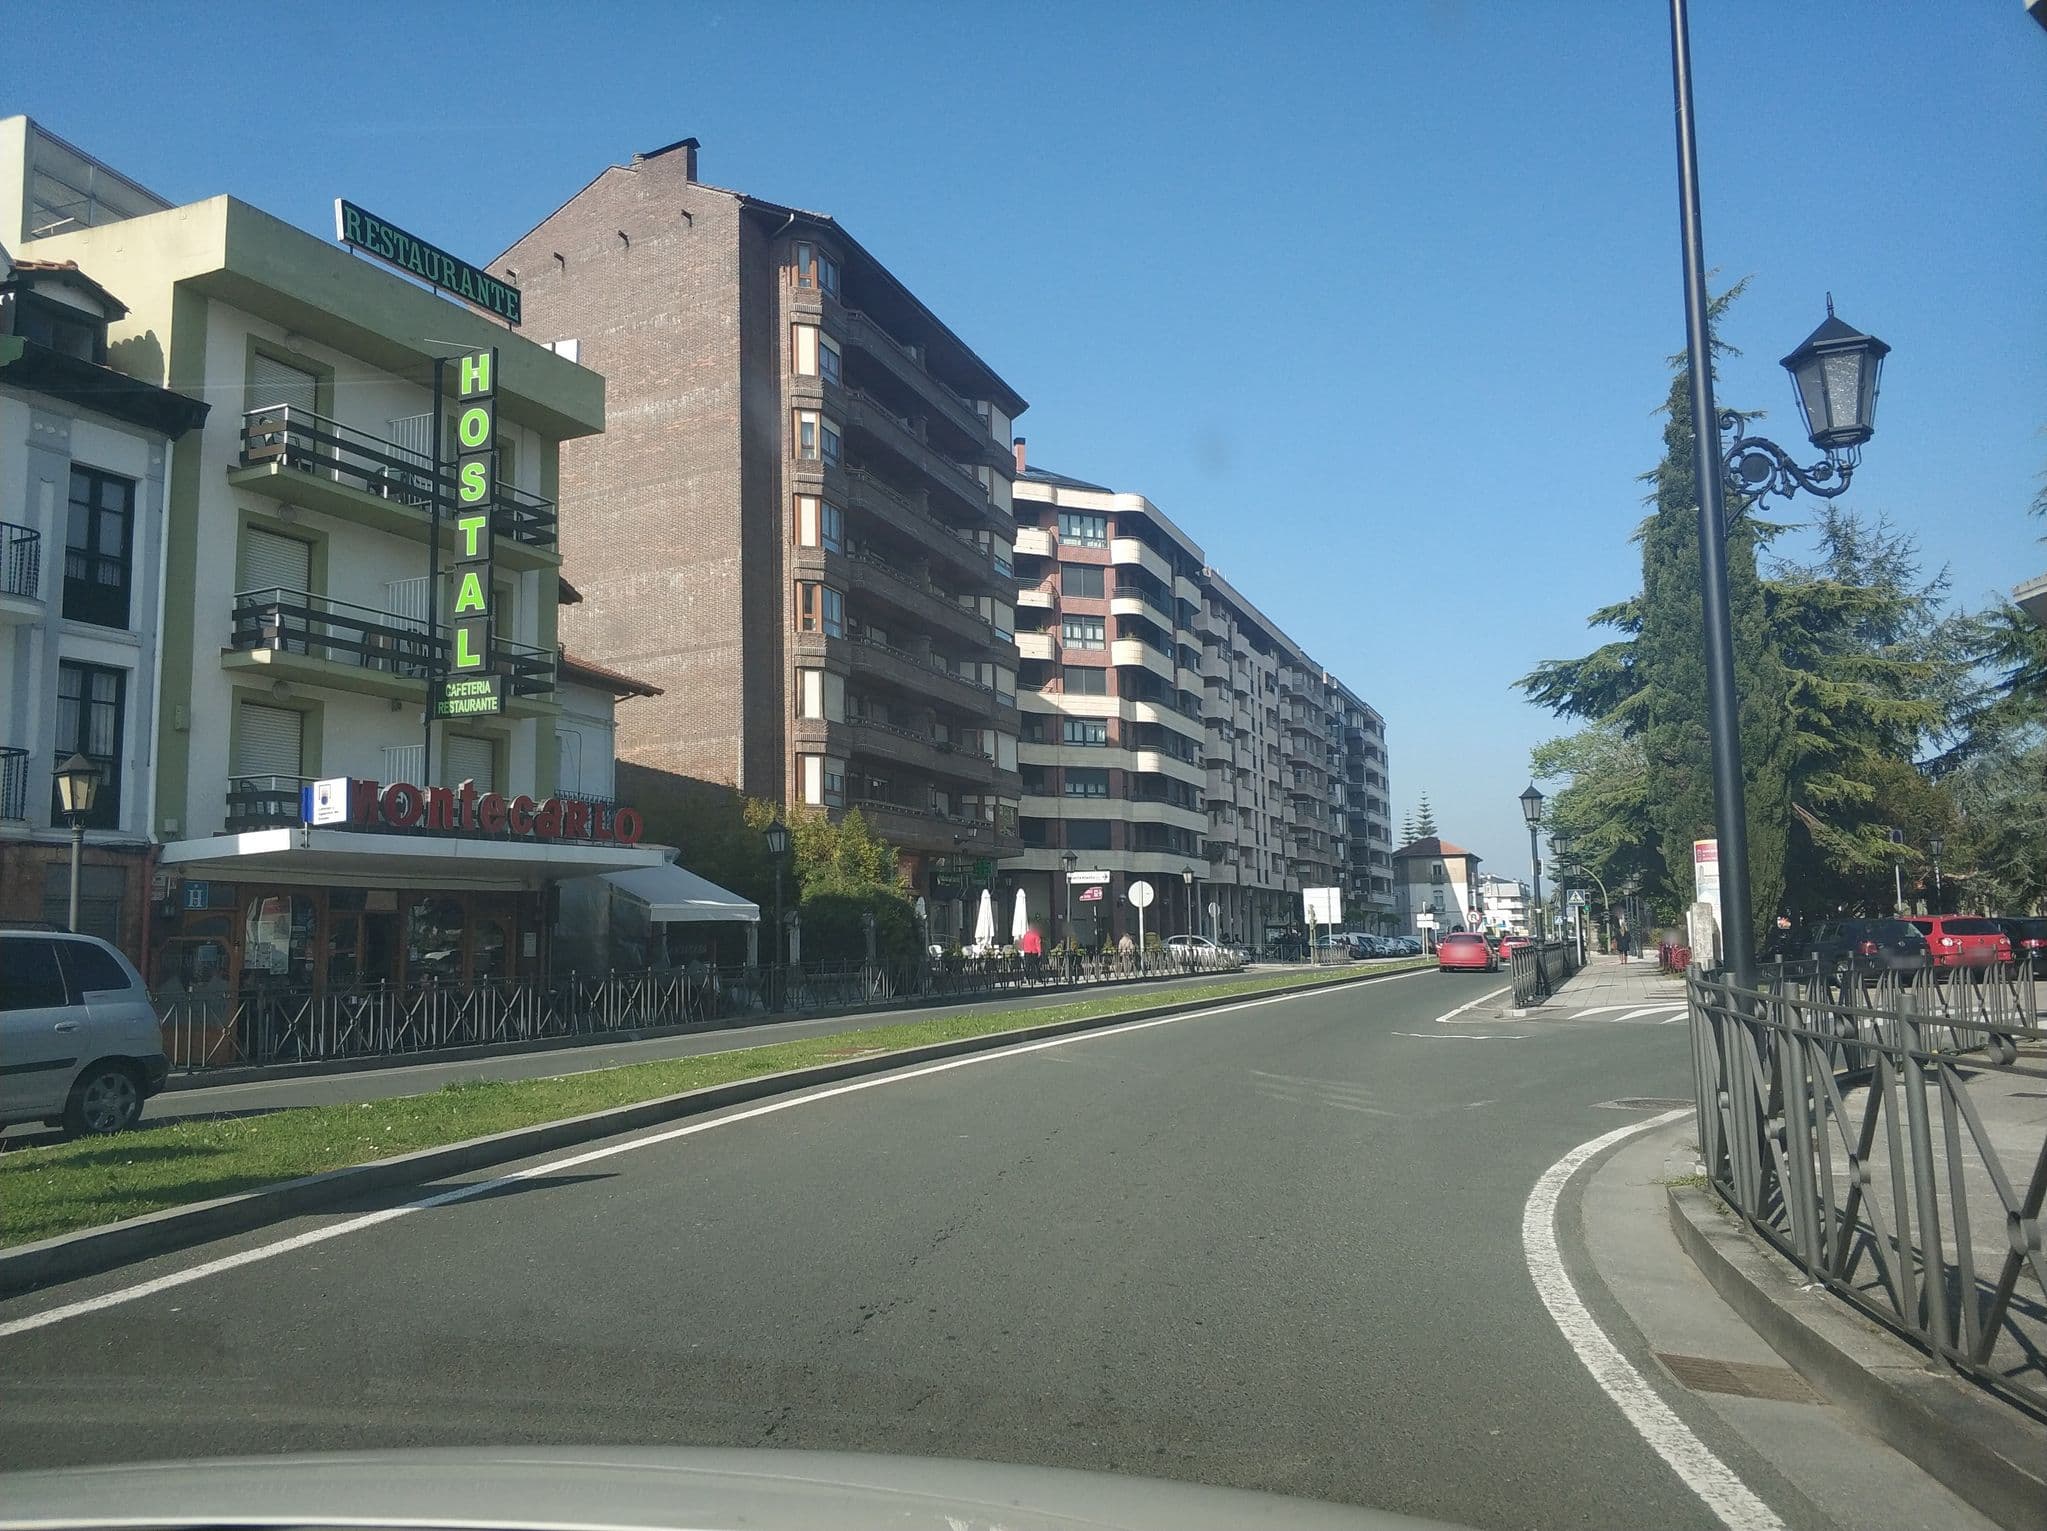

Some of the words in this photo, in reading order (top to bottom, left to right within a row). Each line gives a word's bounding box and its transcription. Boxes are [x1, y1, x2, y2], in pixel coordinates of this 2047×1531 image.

[343, 205, 520, 322] RESTAURANTE
[454, 353, 490, 668] HOSTAL
[438, 696, 498, 714] RESTAURANTE
[445, 680, 492, 698] CAFETERIA
